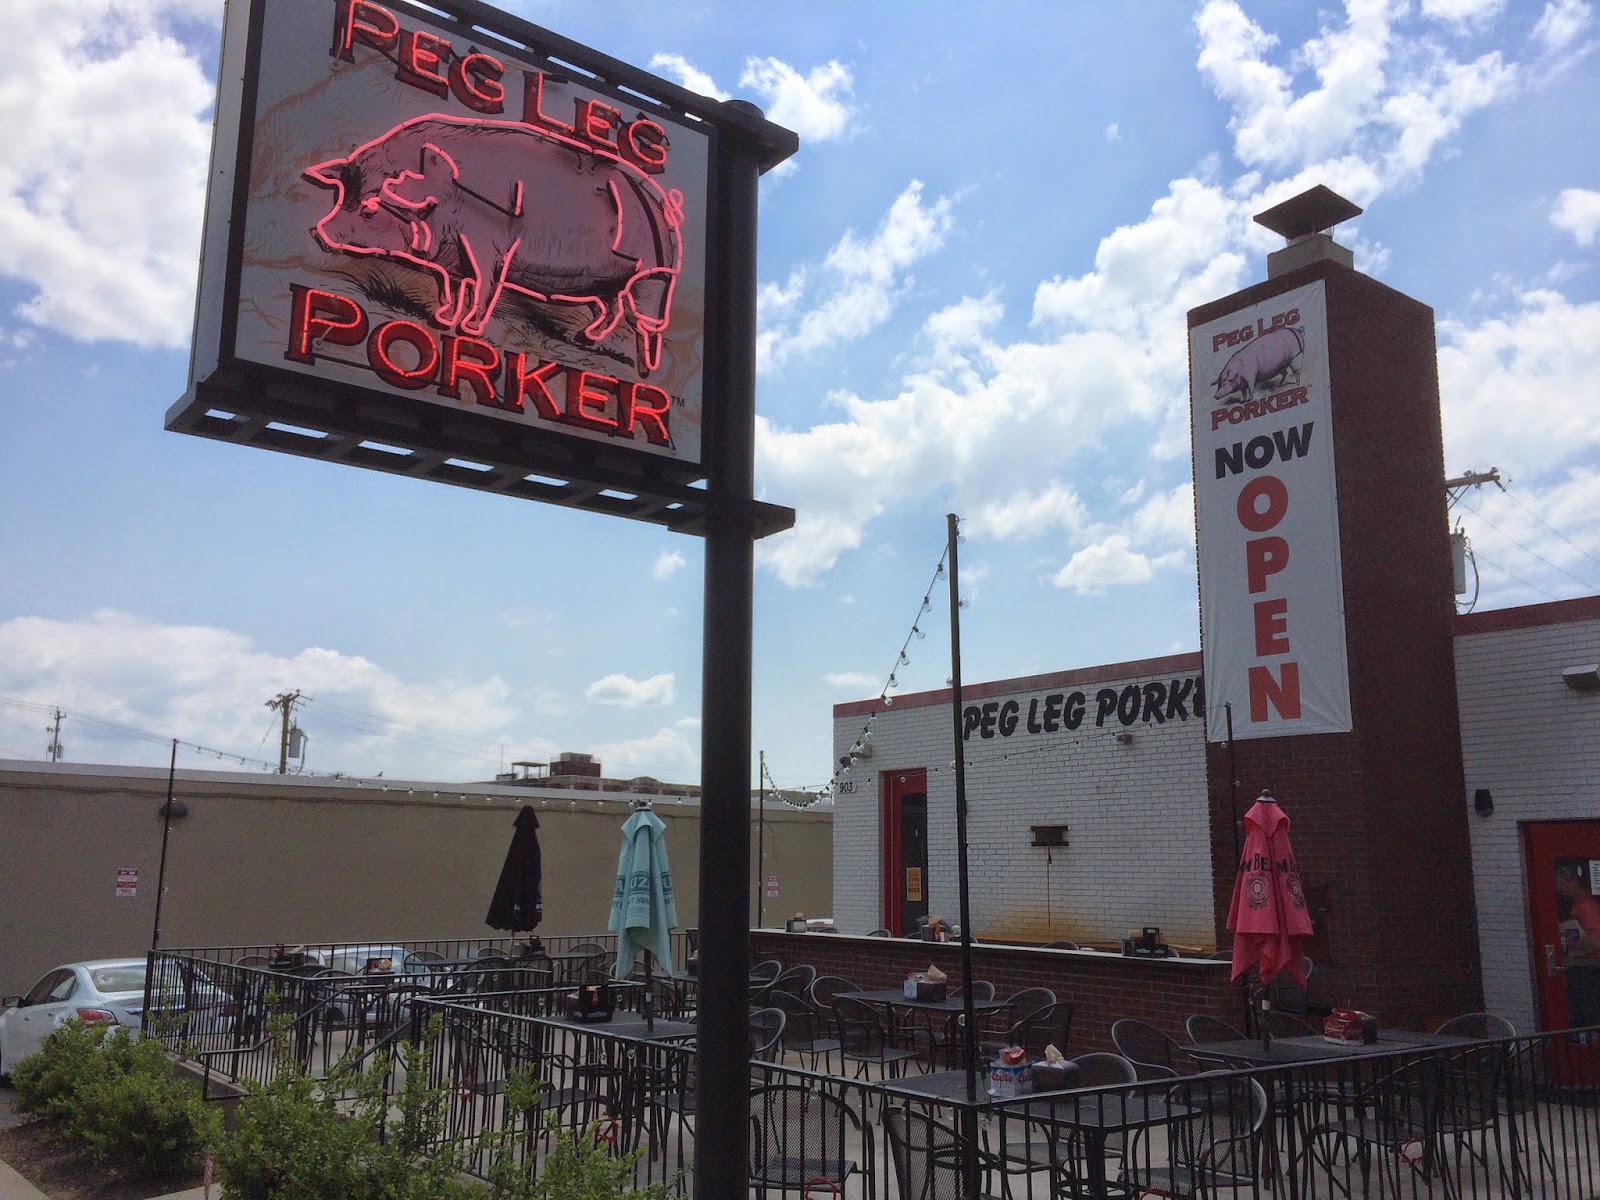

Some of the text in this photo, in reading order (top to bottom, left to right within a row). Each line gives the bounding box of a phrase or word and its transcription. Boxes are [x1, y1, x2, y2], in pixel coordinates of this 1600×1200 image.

[330, 0, 668, 176] PEG LEG
[1212, 308, 1300, 353] PEG LEG
[285, 282, 671, 447] PORKER
[1211, 386, 1309, 431] PORKER
[1214, 421, 1314, 480] NOW
[1236, 475, 1302, 723] OPEN
[963, 700, 1019, 741] PEG
[1026, 691, 1086, 734] LEG
[840, 781, 853, 793] 903
